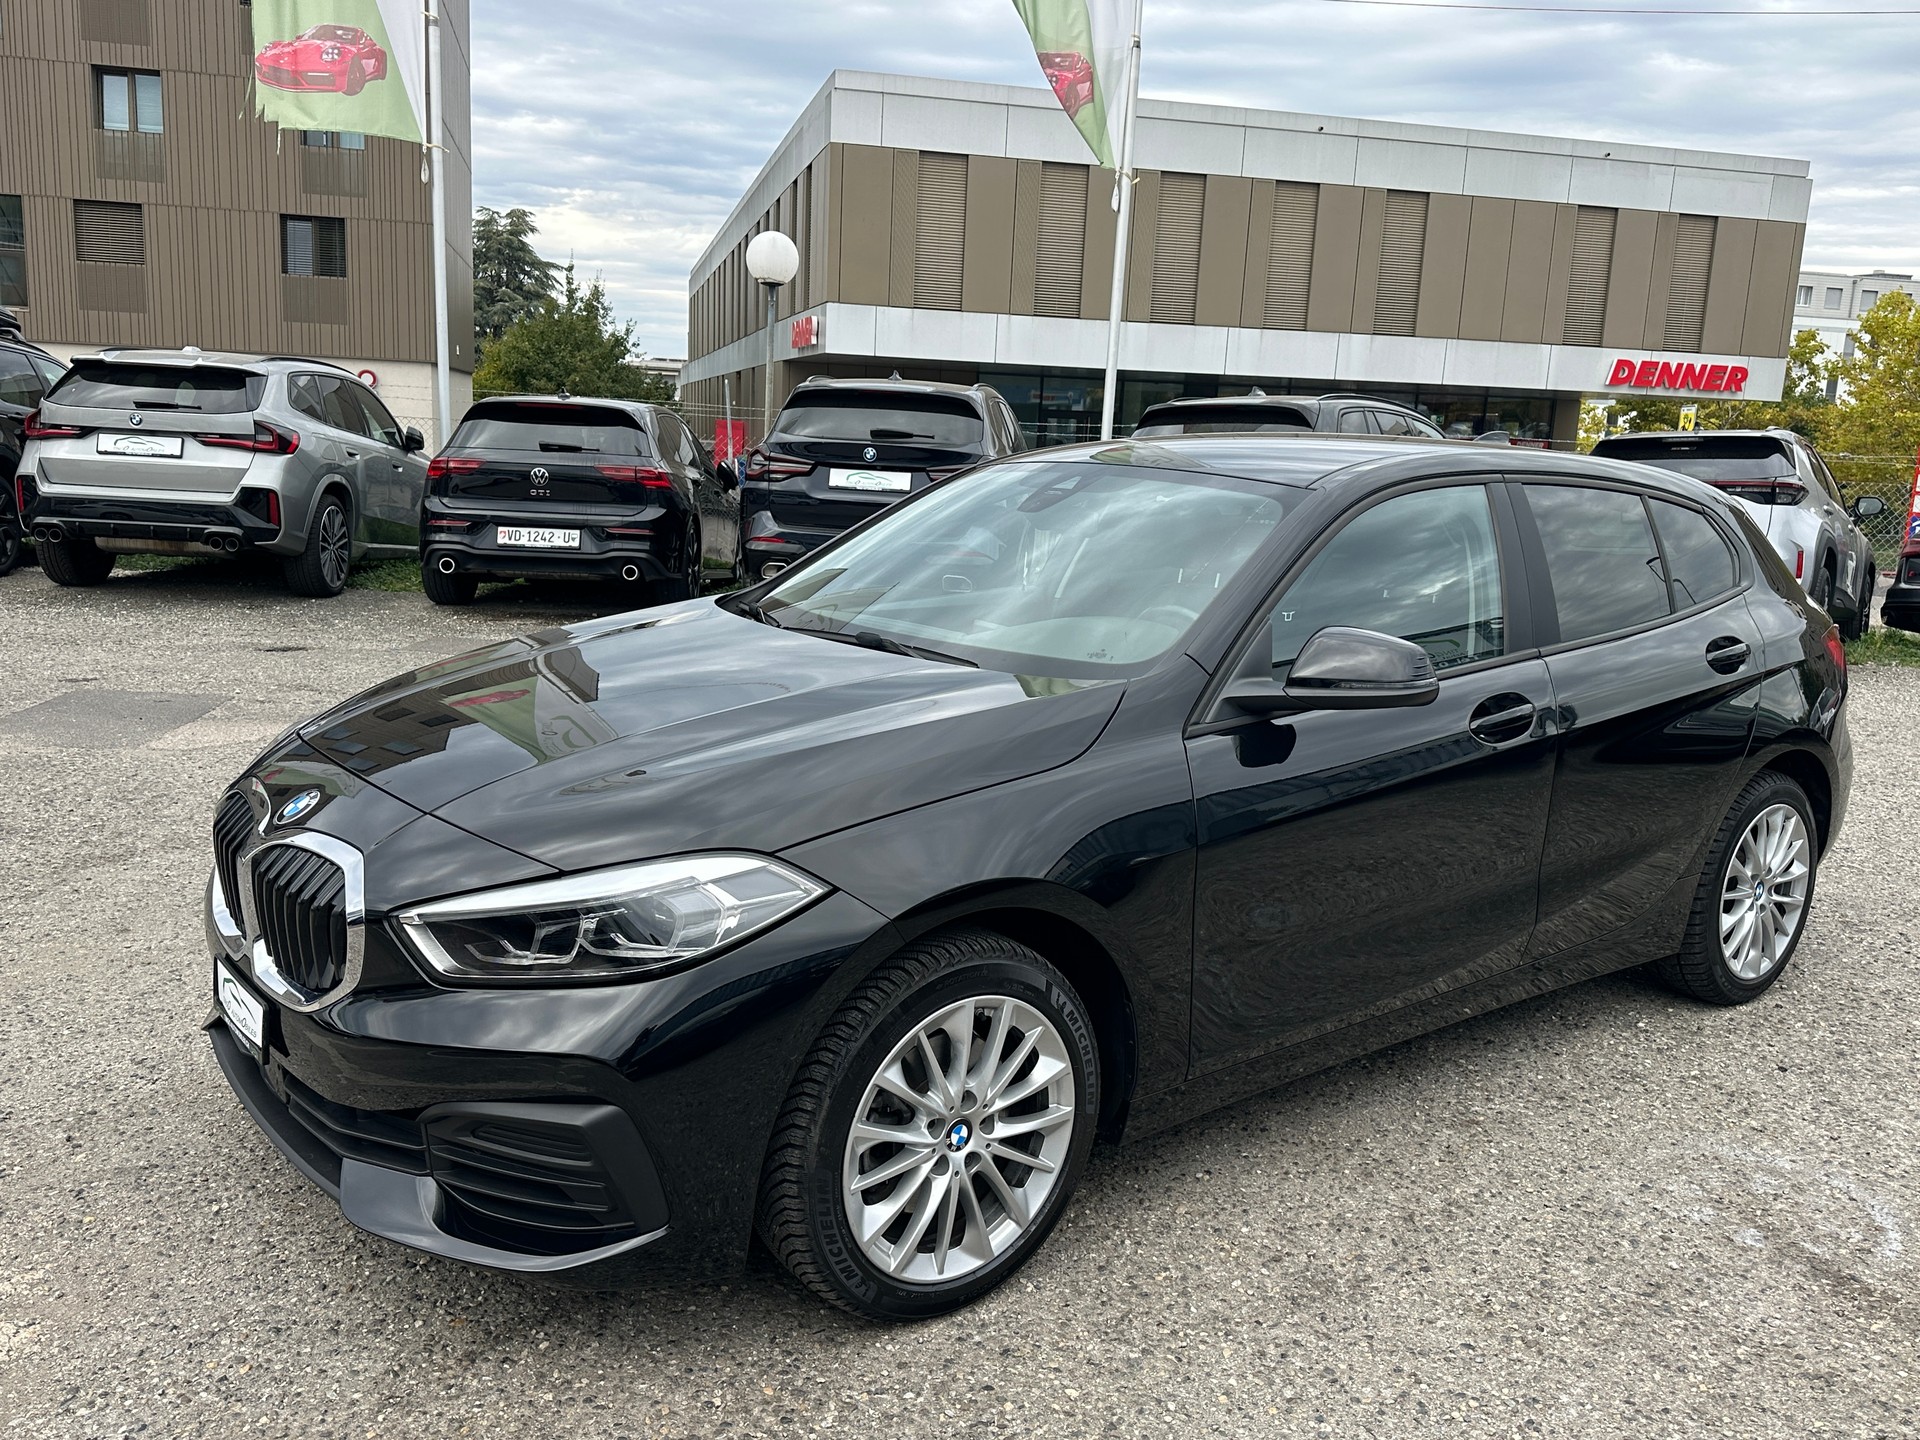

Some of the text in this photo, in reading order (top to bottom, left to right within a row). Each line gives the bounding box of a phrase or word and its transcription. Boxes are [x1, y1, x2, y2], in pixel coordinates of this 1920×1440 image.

[1606, 358, 1749, 393] DENNER
[530, 489, 551, 497] GTI
[1065, 1010, 1096, 1106] MICHELIN
[816, 1177, 859, 1282] MICHELIN
